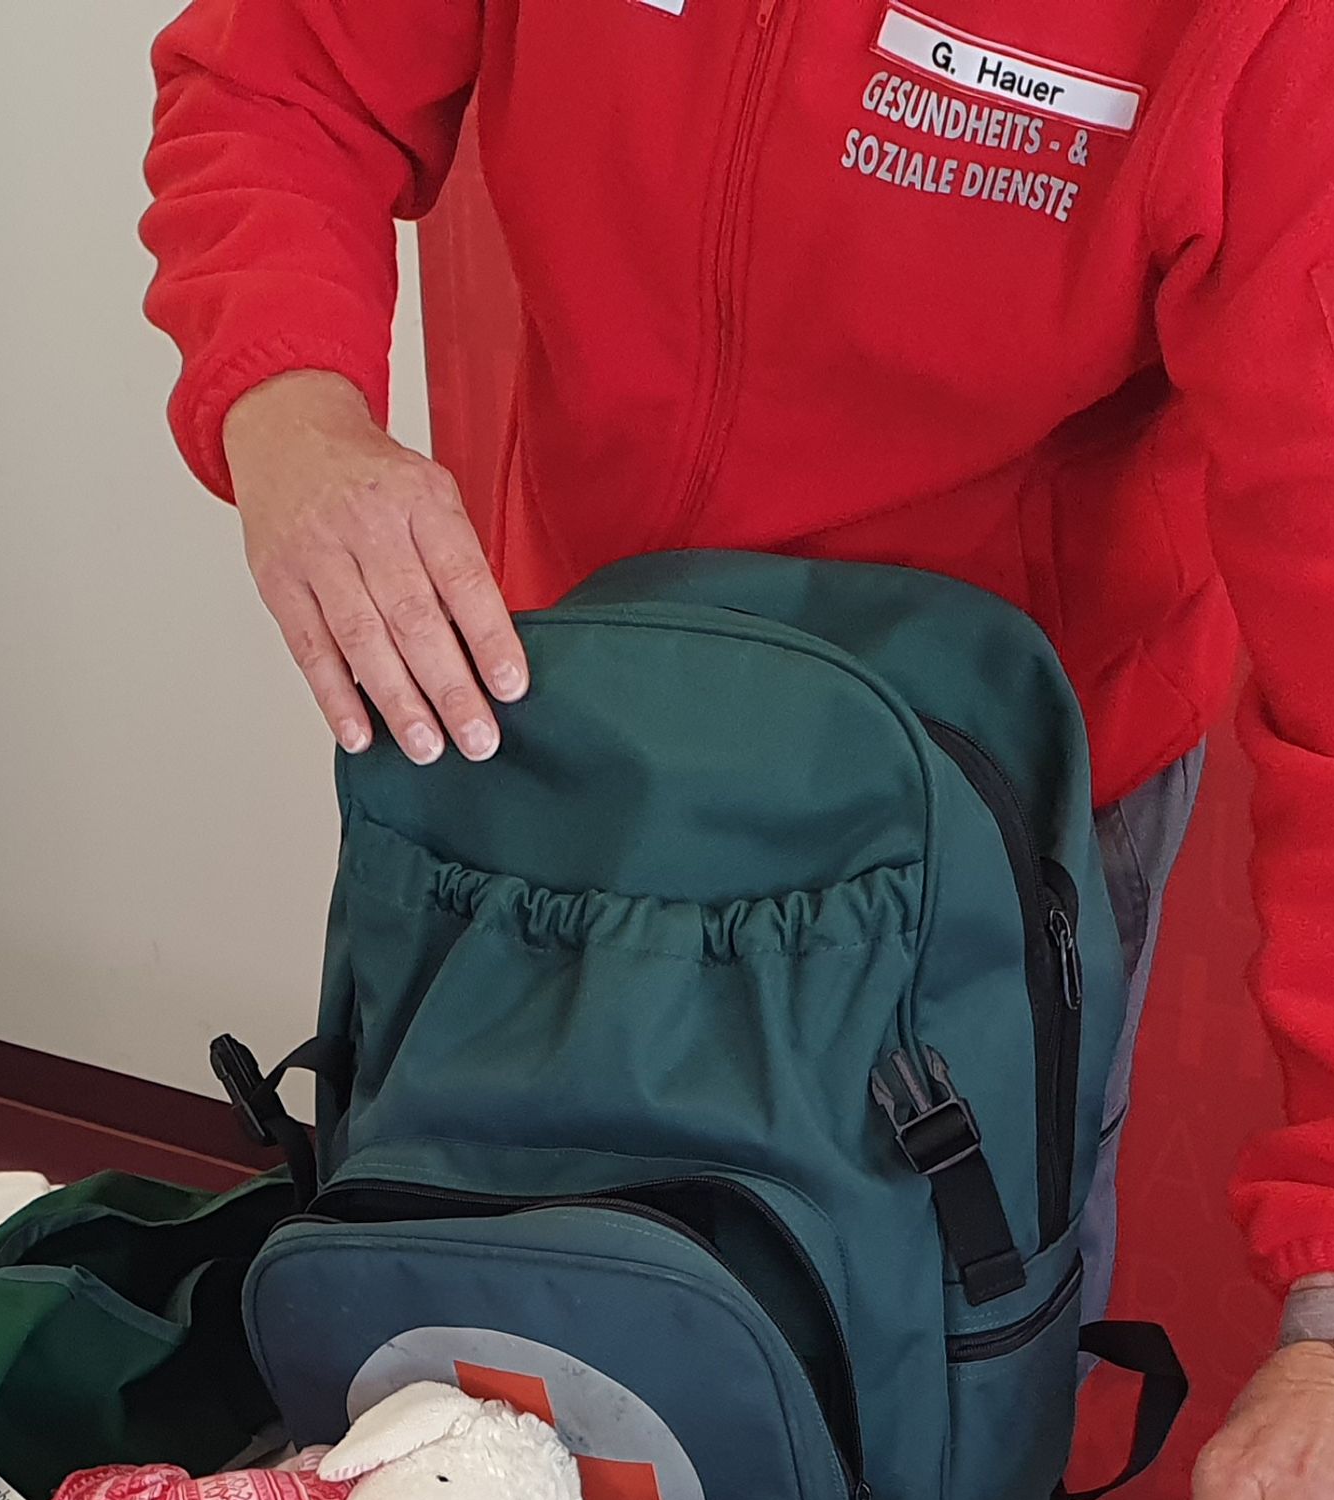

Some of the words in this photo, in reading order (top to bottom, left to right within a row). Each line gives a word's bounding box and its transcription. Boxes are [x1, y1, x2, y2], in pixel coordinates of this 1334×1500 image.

[862, 71, 1043, 154] GESUNDHEITS
[1067, 129, 1088, 166] &
[931, 41, 956, 74] G.
[976, 56, 1064, 105] Hauer
[841, 128, 958, 194] SOZIALE
[960, 162, 1078, 222] DIENSTE
